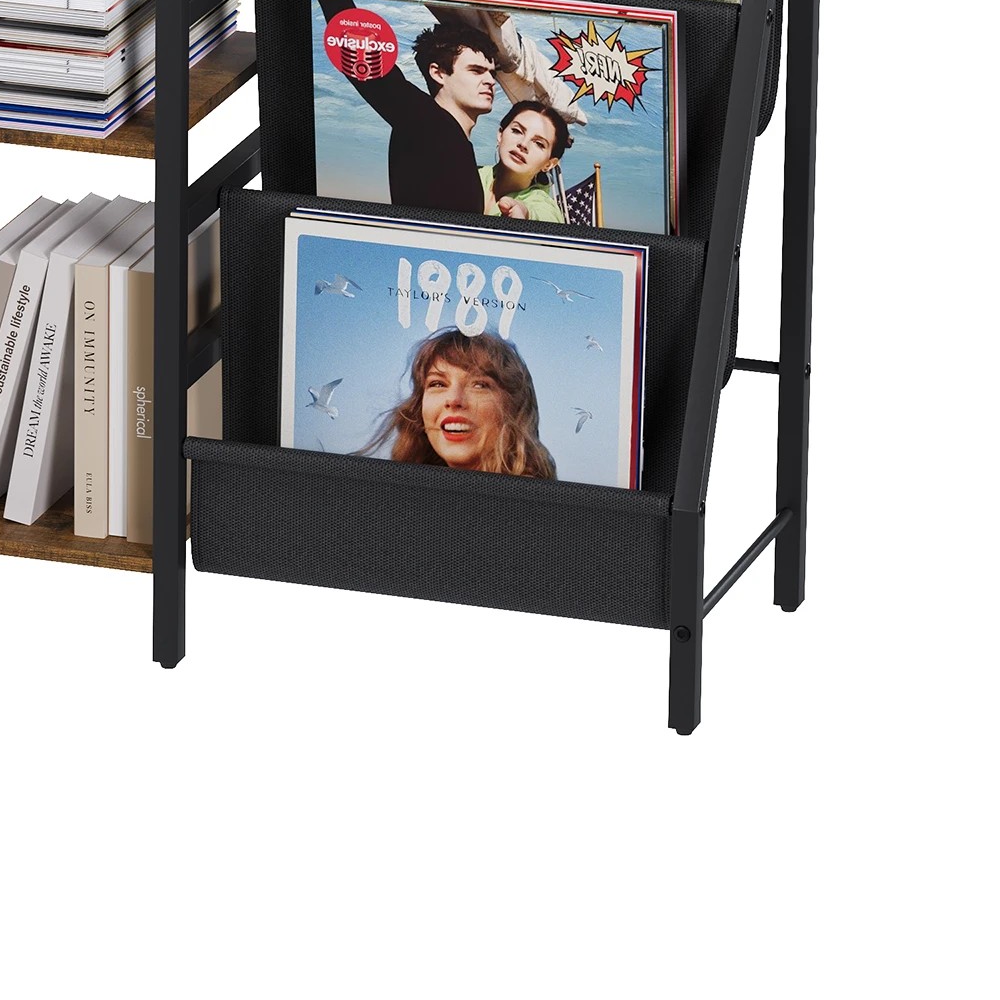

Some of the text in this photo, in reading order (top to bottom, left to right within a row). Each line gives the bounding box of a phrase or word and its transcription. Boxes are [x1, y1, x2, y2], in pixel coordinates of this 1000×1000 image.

[10, 284, 31, 329] lifestyle
[387, 286, 527, 311] TAYLOR'S VERSION
[397, 257, 523, 341] 1989
[23, 322, 57, 458] DREAM the world AWAKE
[84, 300, 96, 416] ON IMMUNITY
[132, 385, 152, 439] spherical
